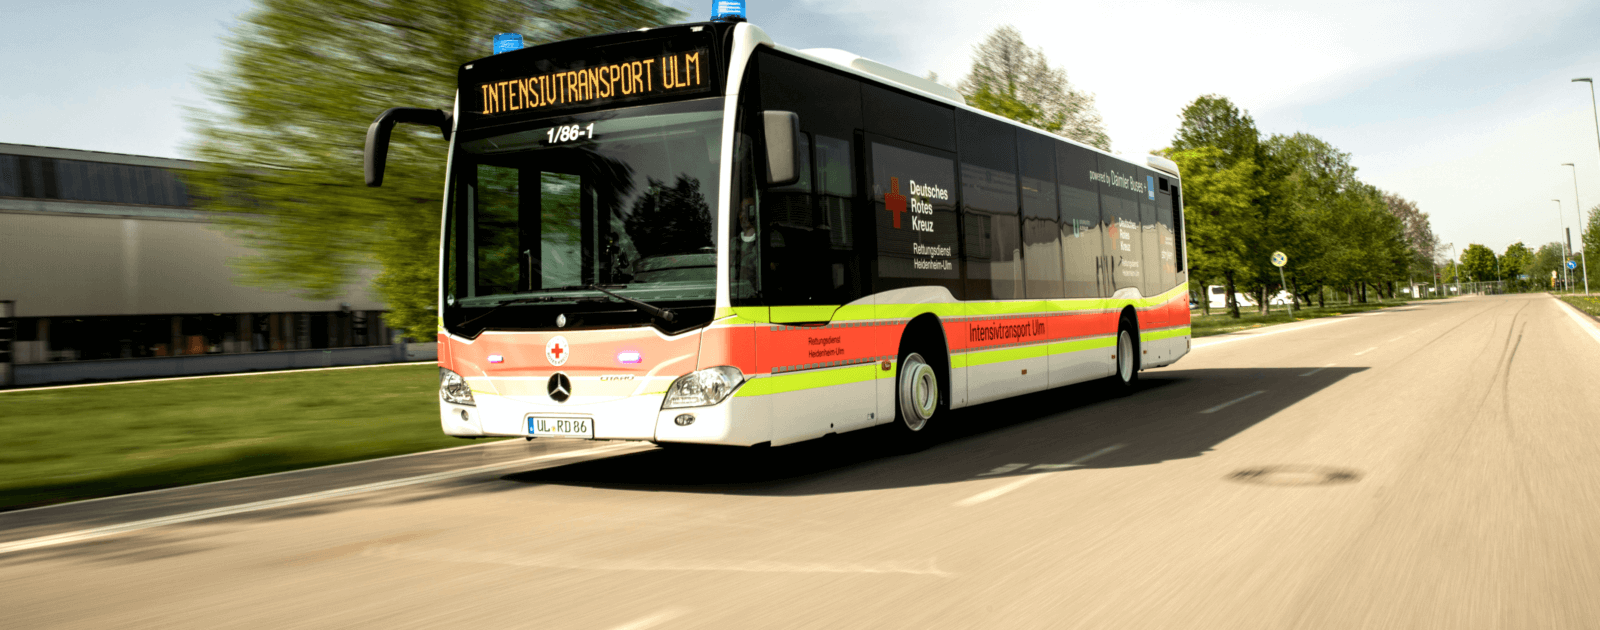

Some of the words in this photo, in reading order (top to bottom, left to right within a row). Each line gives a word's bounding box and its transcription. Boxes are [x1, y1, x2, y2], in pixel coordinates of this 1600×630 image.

[482, 59, 654, 114] INTENSIVTRANSPORT
[662, 52, 700, 89] ULM
[547, 123, 595, 144] 1/86-1
[909, 180, 948, 200] Deutsches
[1111, 169, 1129, 189] Daimler
[1130, 175, 1143, 193] Buses
[911, 198, 933, 215] Rotes
[911, 215, 934, 232] Kreuz
[913, 242, 952, 258] Rettungsdienst
[914, 258, 953, 270] Heidenheim-Ulm
[969, 322, 1031, 342] Intensivtransport
[1032, 318, 1046, 336] Ulm
[536, 419, 551, 432] UL
[557, 420, 571, 433] RD
[573, 420, 587, 433] 86
